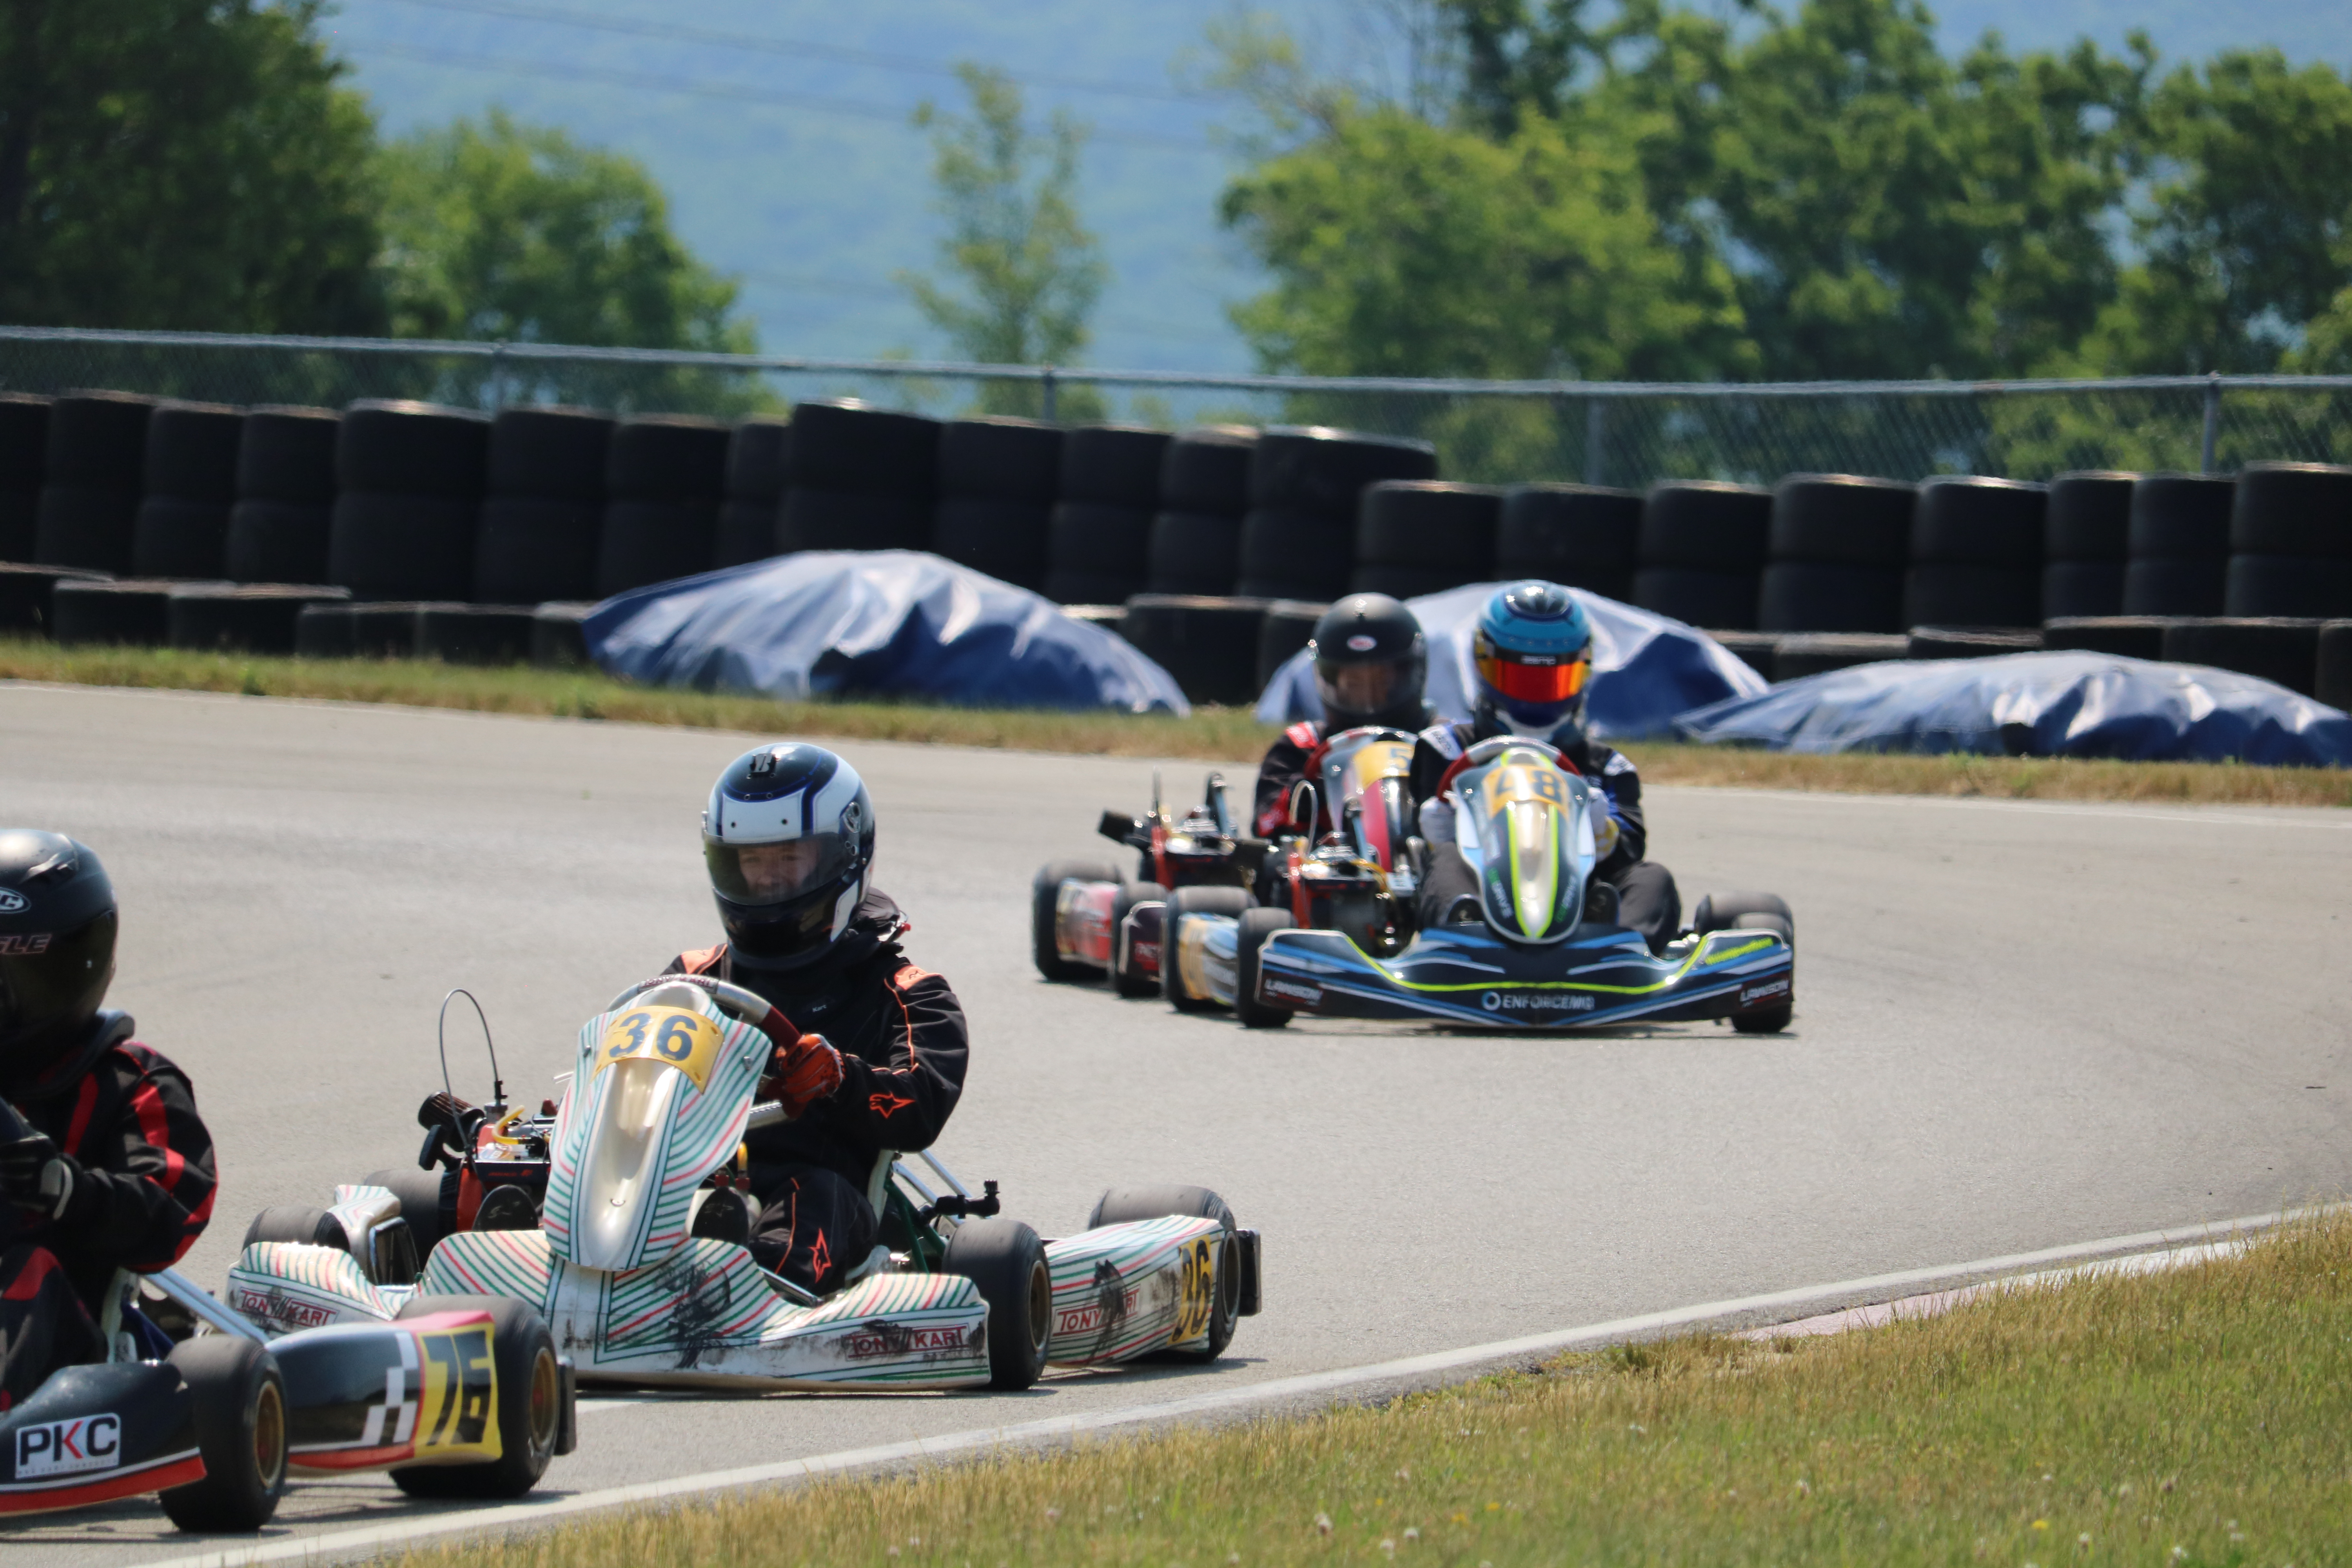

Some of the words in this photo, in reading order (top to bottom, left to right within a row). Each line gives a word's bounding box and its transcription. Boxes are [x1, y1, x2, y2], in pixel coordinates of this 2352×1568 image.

[609, 1013, 698, 1062] 36
[1172, 1240, 1210, 1342] 36
[913, 1326, 967, 1348] KART
[1058, 1304, 1102, 1332] TONY
[422, 1330, 492, 1446] 76
[20, 1416, 117, 1466] PKC
